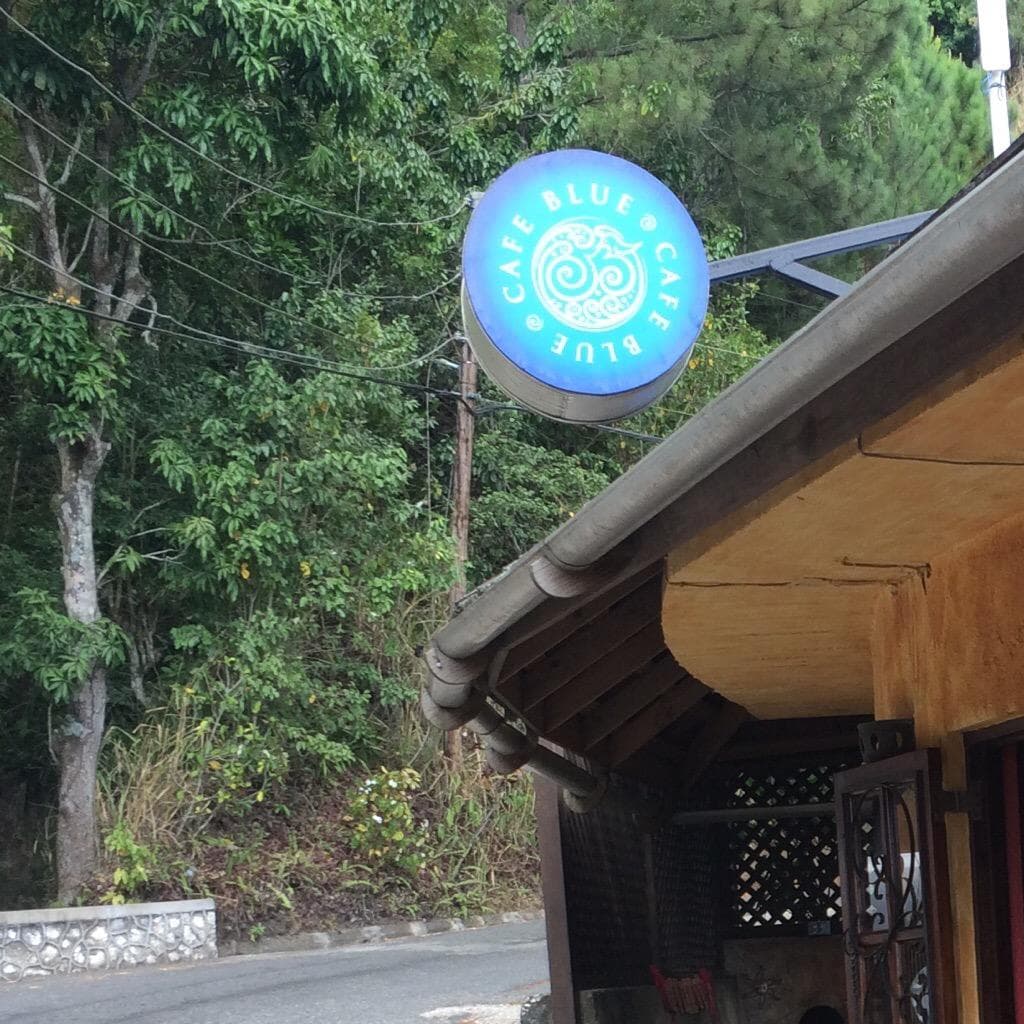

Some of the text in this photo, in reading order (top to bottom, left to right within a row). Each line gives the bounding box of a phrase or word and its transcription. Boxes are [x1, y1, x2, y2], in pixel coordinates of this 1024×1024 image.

[499, 183, 635, 304] CAFE BLUE
[550, 241, 681, 364] CAFE BLUE
